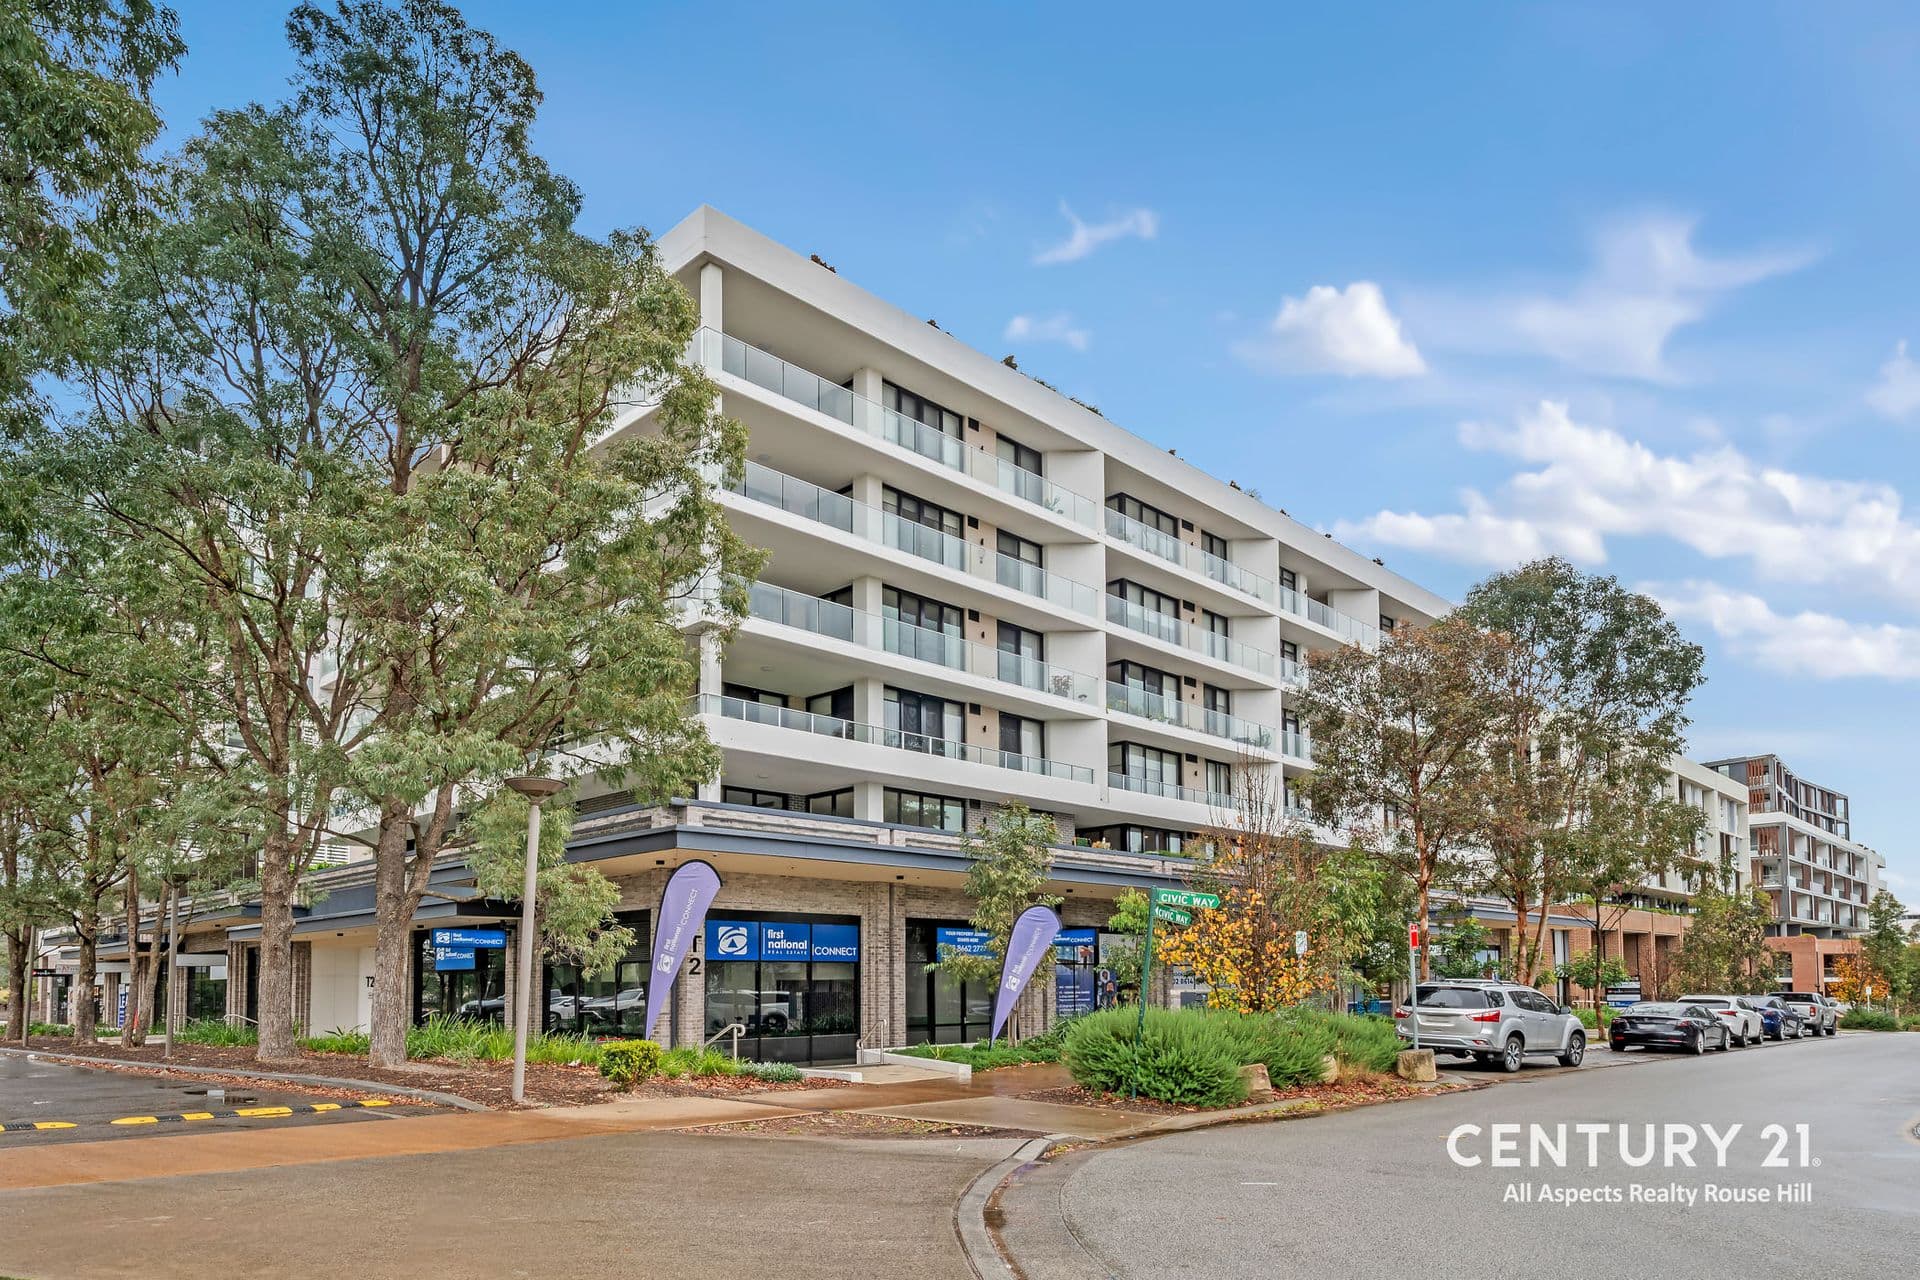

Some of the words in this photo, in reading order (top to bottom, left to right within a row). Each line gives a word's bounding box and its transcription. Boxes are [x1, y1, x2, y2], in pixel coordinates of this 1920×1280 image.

[681, 888, 699, 926] CONNECT
[1161, 893, 1188, 905] CIVIC
[1193, 897, 1215, 907] WAY
[1158, 908, 1174, 920] CIVIC
[1175, 913, 1189, 924] WAY
[768, 929, 784, 939] first
[768, 940, 808, 950] national
[814, 946, 857, 956] CONNECT
